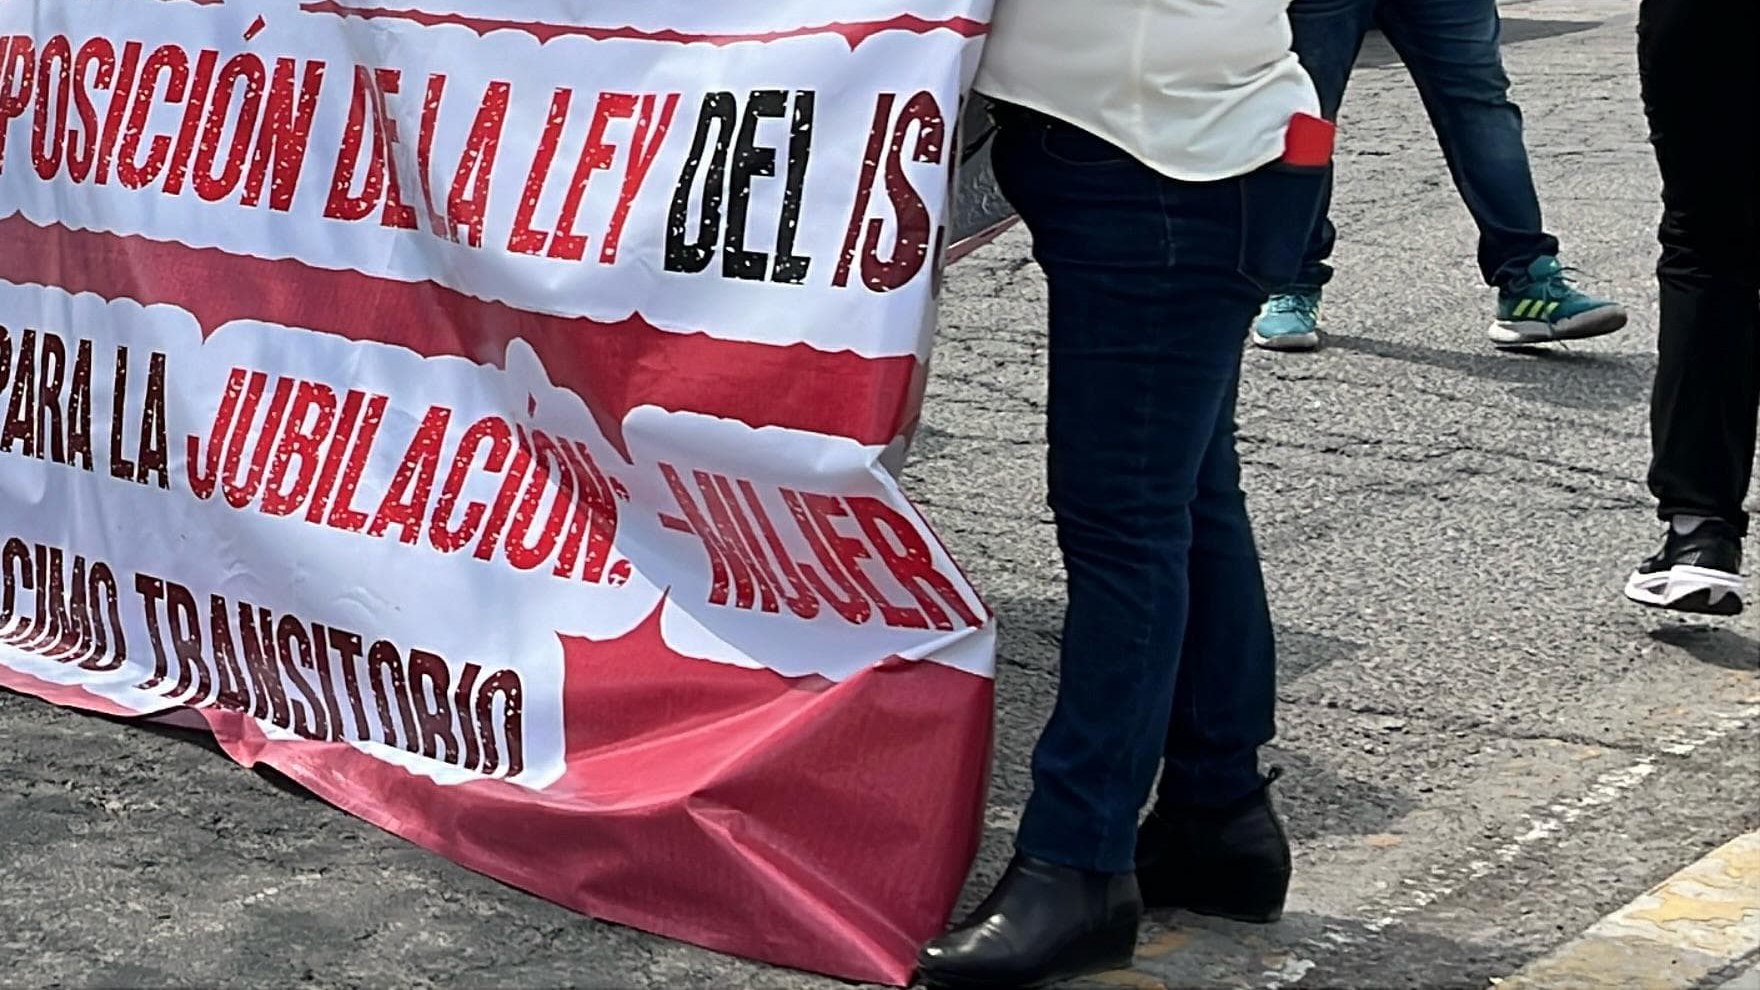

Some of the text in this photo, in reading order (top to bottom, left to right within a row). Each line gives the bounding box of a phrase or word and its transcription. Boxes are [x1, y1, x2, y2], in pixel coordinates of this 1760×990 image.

[323, 63, 419, 230] DE
[418, 71, 511, 249] LA
[507, 86, 680, 266] LEY
[663, 89, 817, 287] DEL
[830, 90, 957, 298] IS
[109, 345, 170, 490] LA
[186, 367, 633, 588] JUBILACIÓN:
[134, 572, 524, 778] TRANSITORIO
